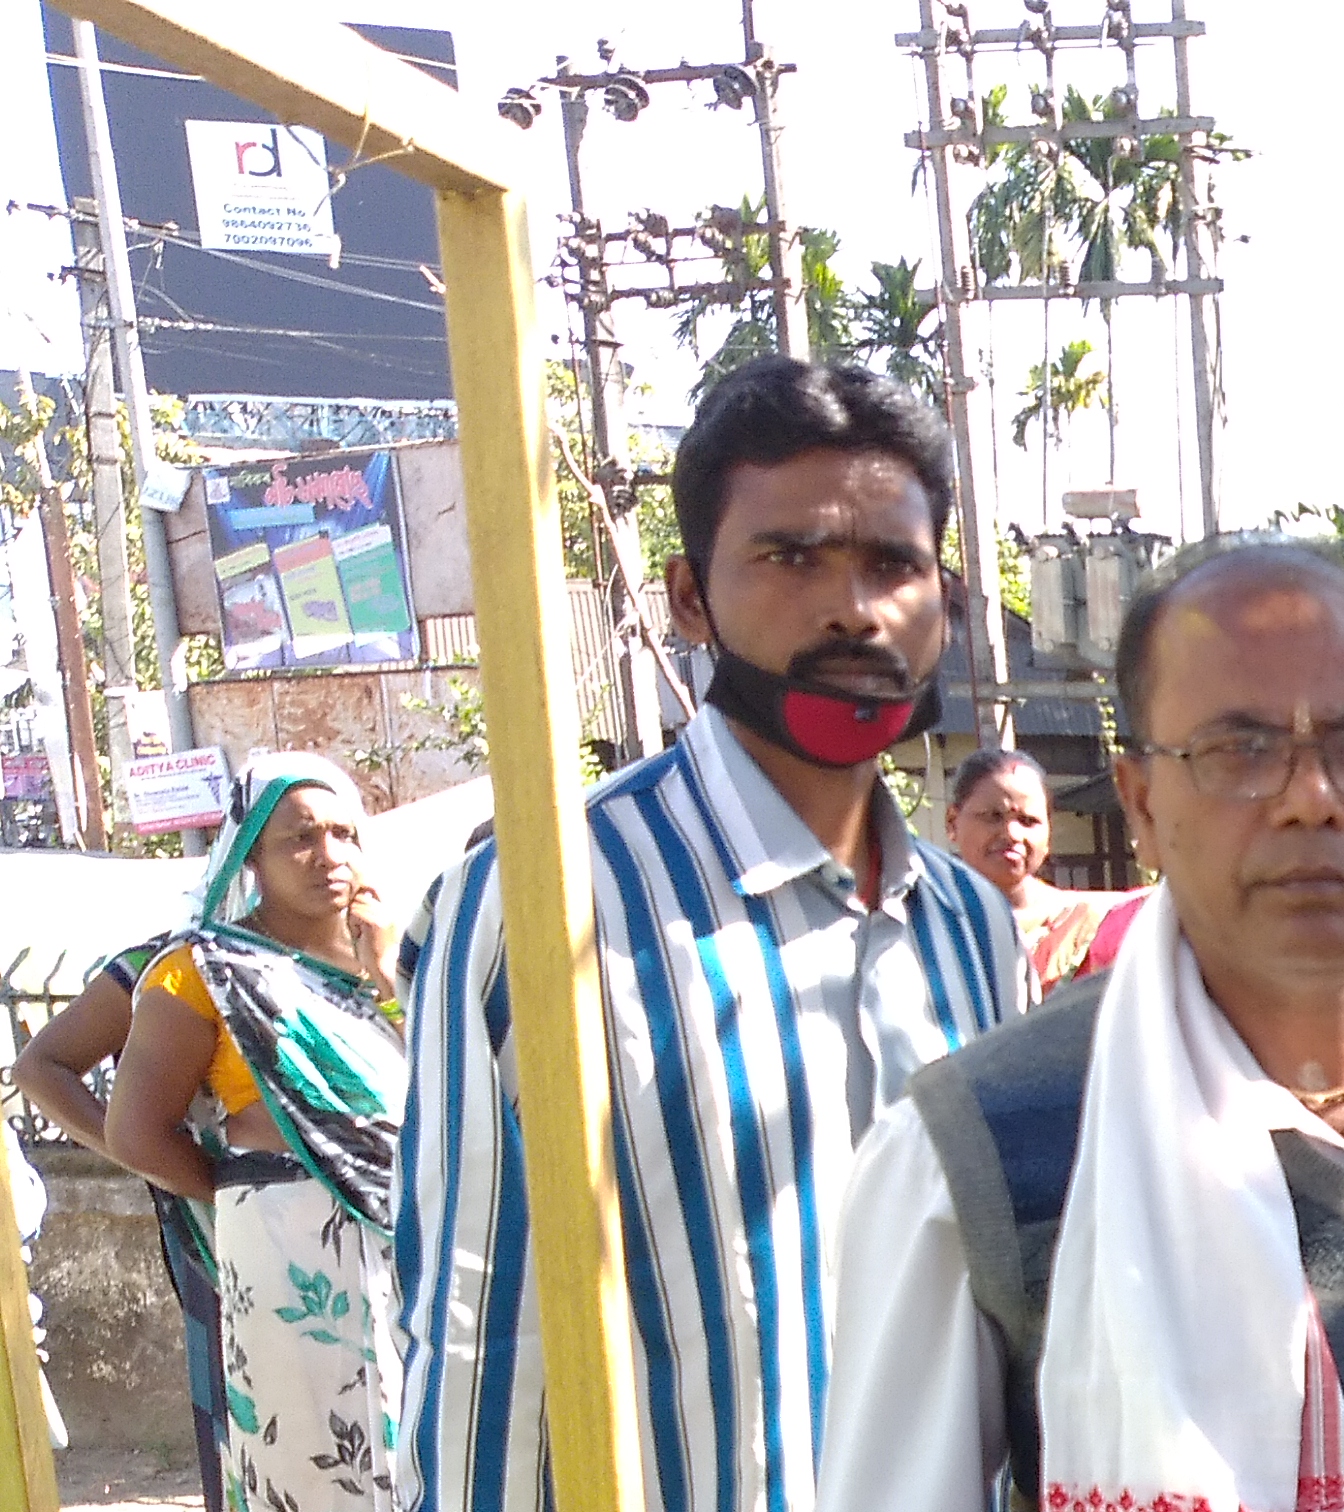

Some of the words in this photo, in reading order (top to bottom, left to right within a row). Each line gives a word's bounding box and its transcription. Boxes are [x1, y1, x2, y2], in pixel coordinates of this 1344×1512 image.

[223, 203, 281, 217] Contact
[129, 761, 174, 778] ADITYA
[175, 753, 217, 770] CLINIC
